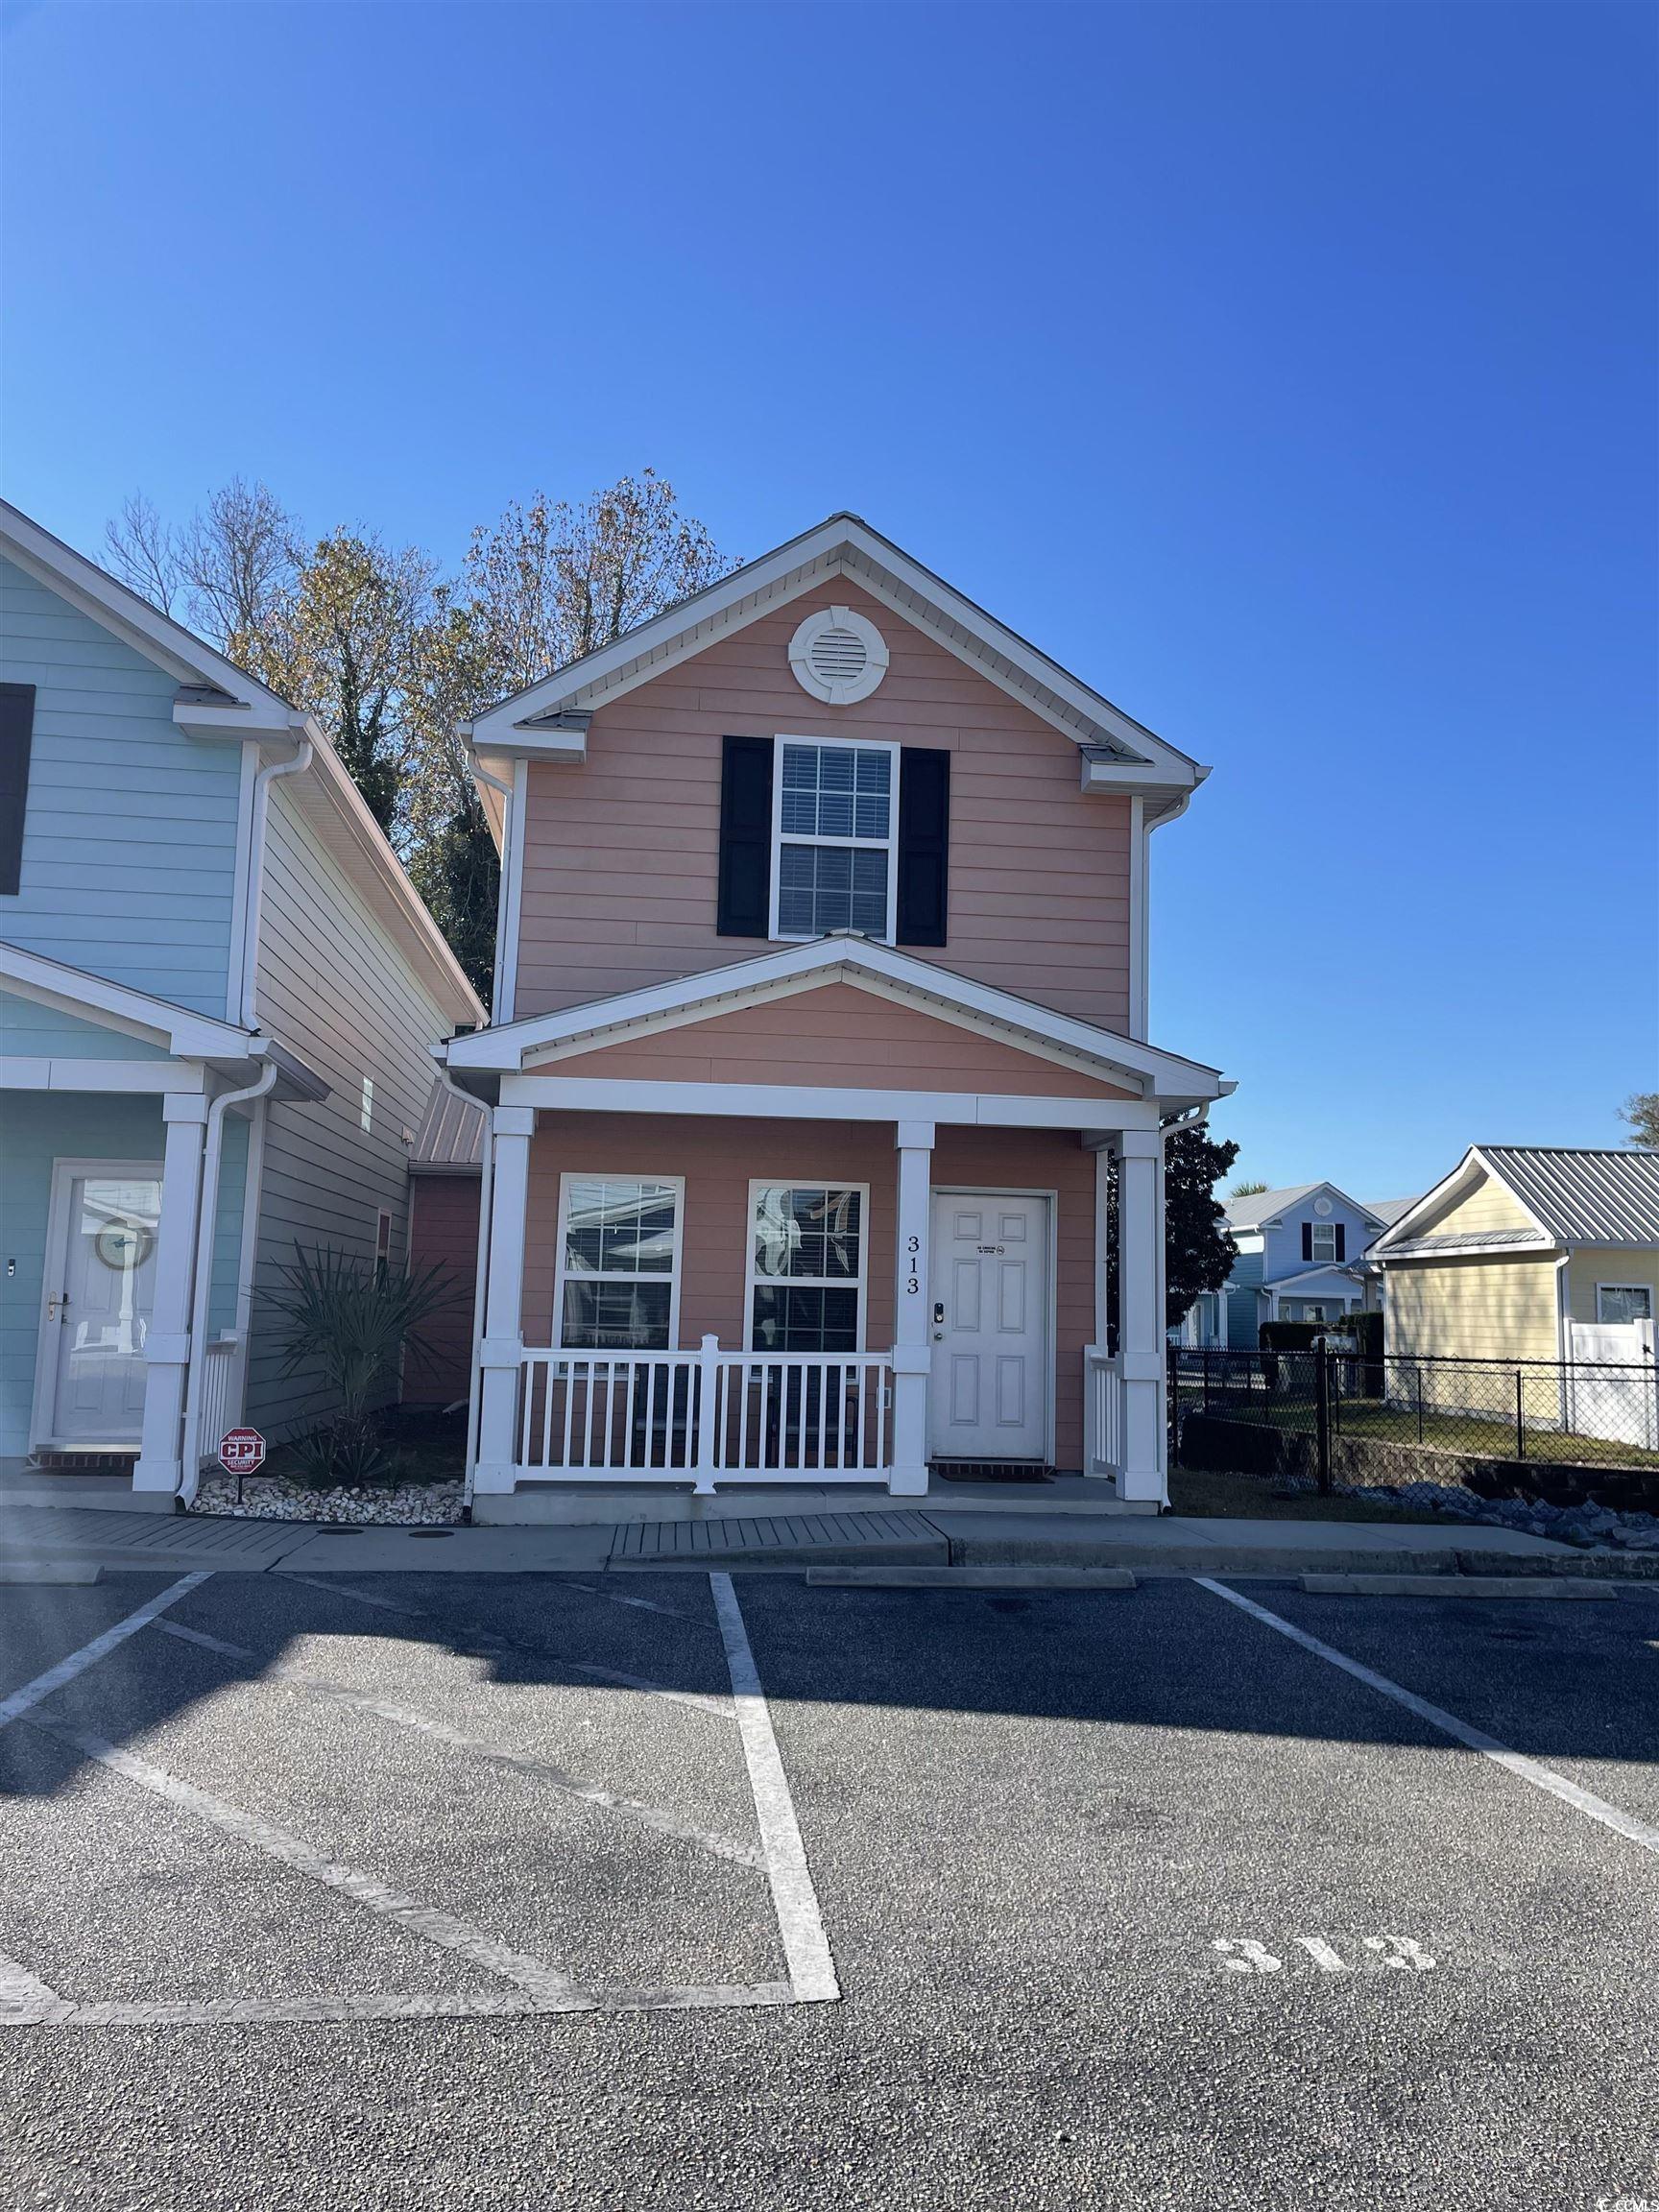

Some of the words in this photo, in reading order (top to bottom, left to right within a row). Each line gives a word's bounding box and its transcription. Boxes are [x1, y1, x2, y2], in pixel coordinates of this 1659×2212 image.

[907, 1236, 920, 1294] 313
[222, 1443, 261, 1457] CPI
[1212, 1936, 1437, 1973] 313
